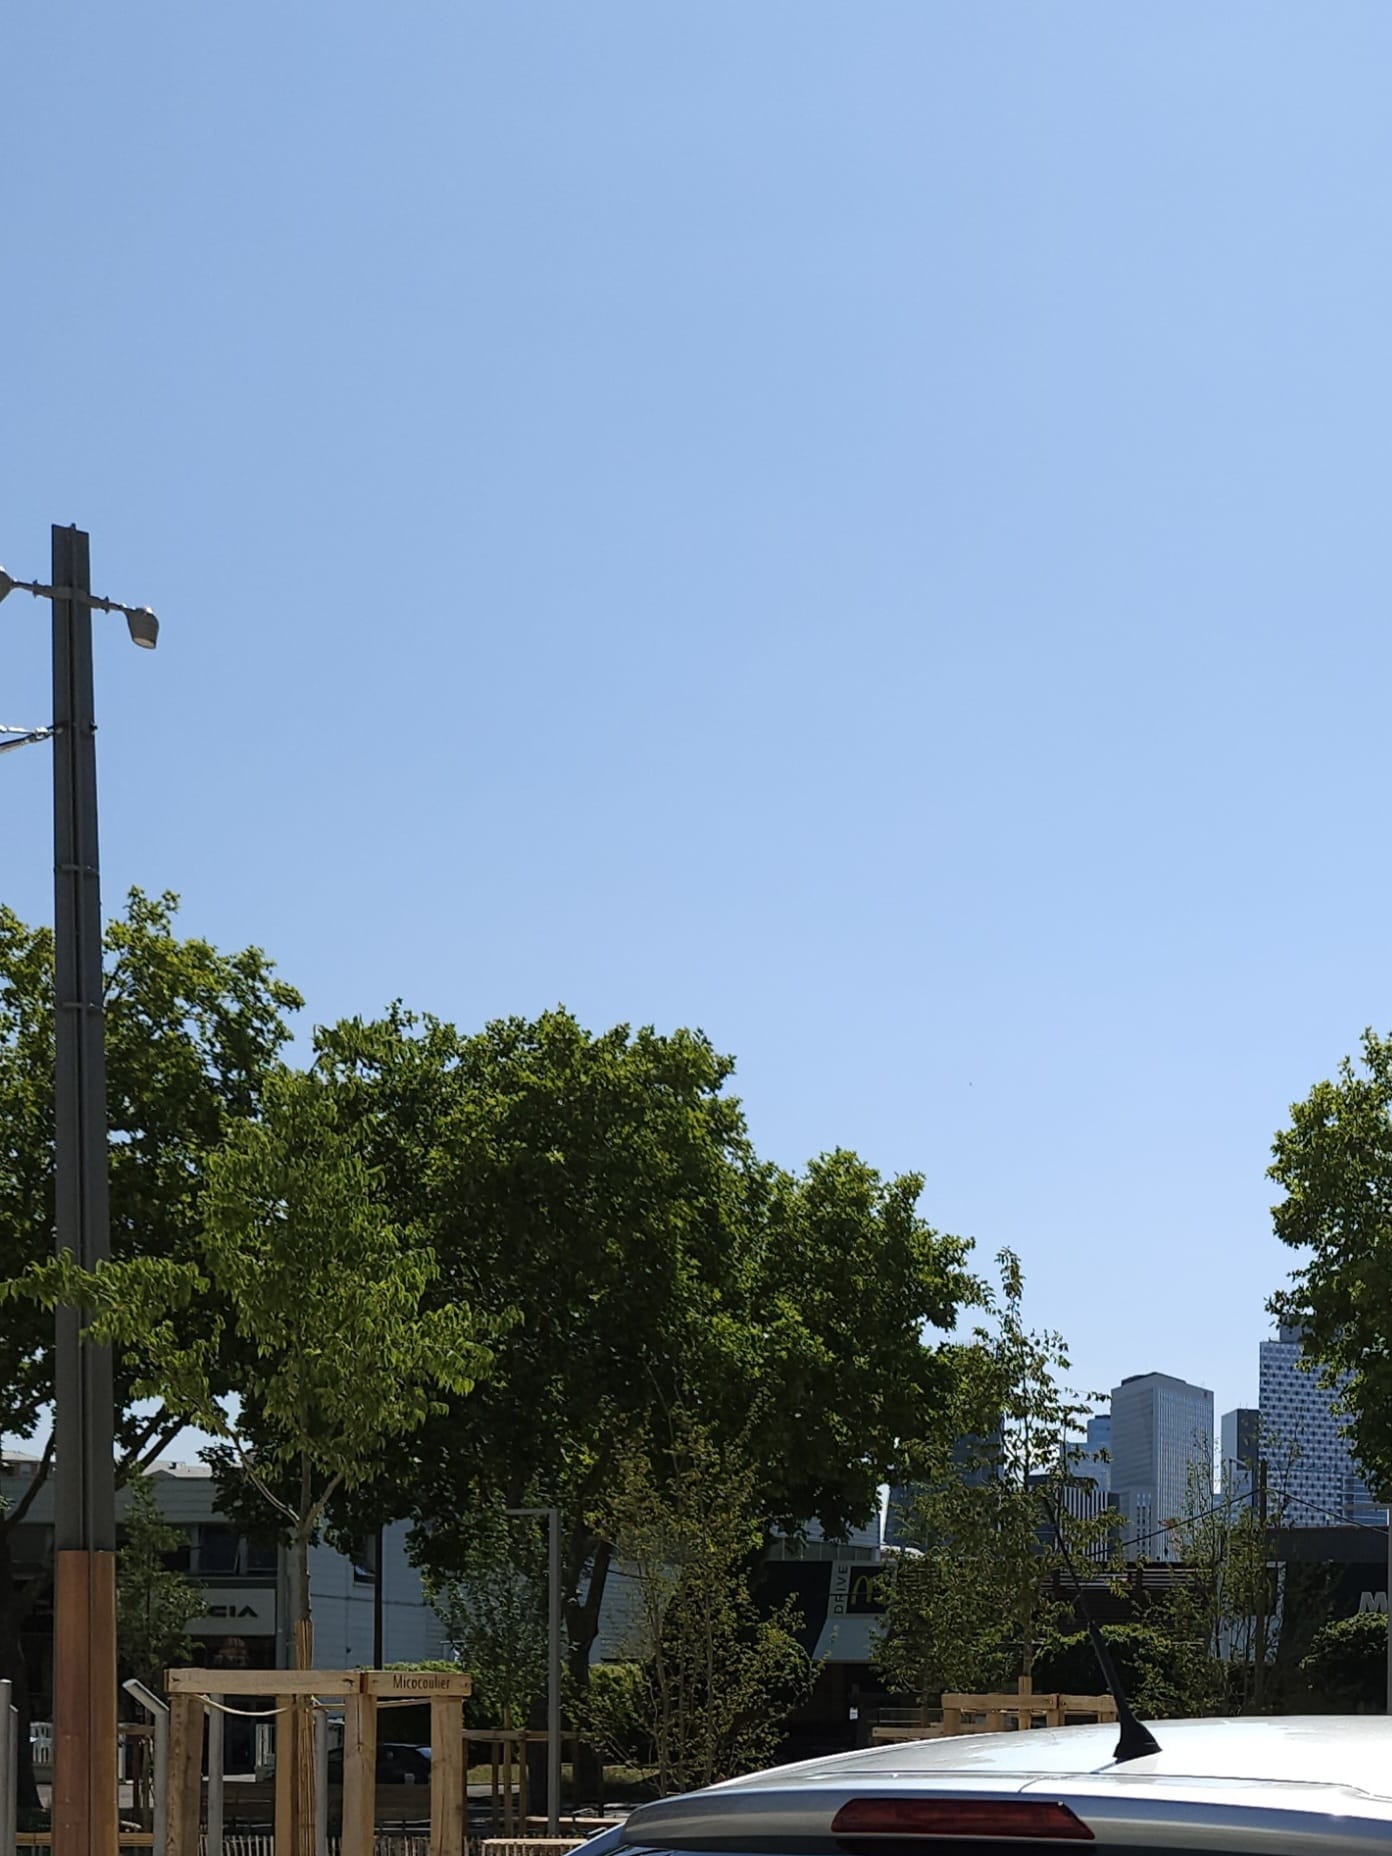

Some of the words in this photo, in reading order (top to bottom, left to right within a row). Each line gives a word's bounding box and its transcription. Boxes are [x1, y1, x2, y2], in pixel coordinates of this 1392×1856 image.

[834, 1565, 848, 1614] DRIVE
[207, 1605, 259, 1618] CIA
[393, 1674, 450, 1689] Micocoulier
